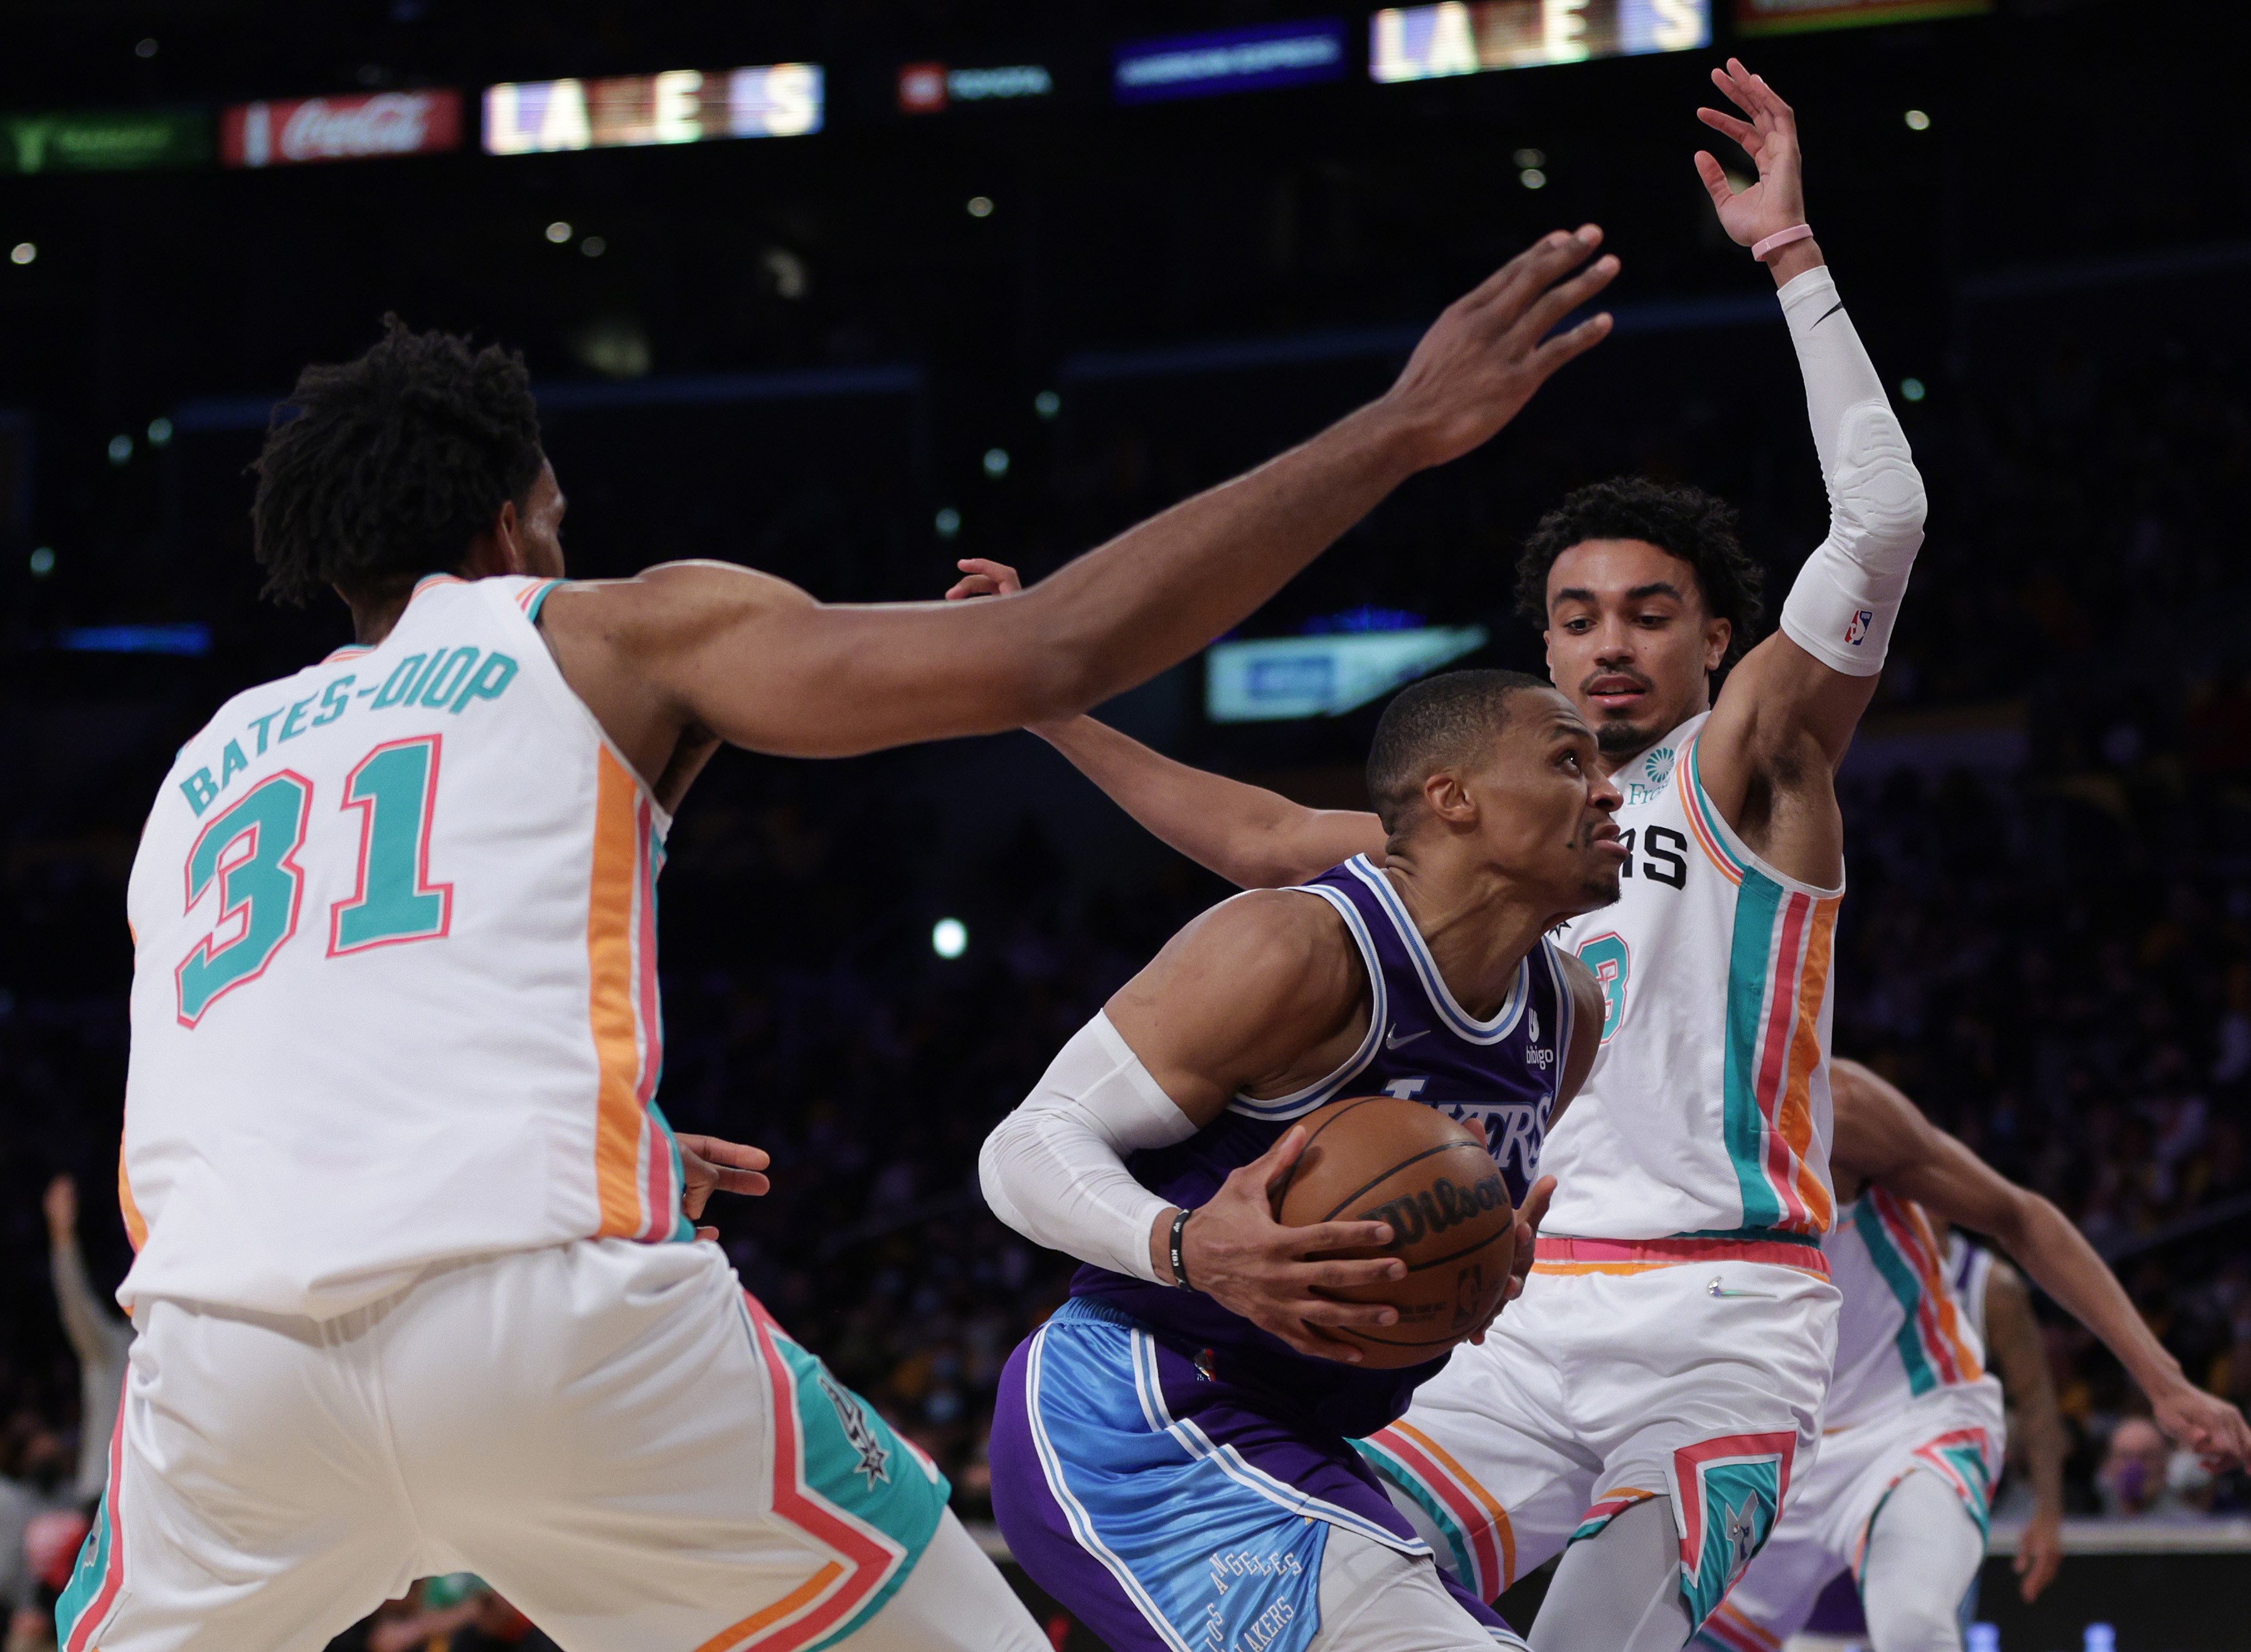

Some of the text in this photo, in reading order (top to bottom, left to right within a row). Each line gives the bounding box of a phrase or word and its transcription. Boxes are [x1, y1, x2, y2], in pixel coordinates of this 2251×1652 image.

[179, 646, 519, 818] BATES-DIOP
[174, 733, 454, 1030] 31
[1526, 1045, 1553, 1070] bibigo
[1210, 1552, 1302, 1596] ANGELES
